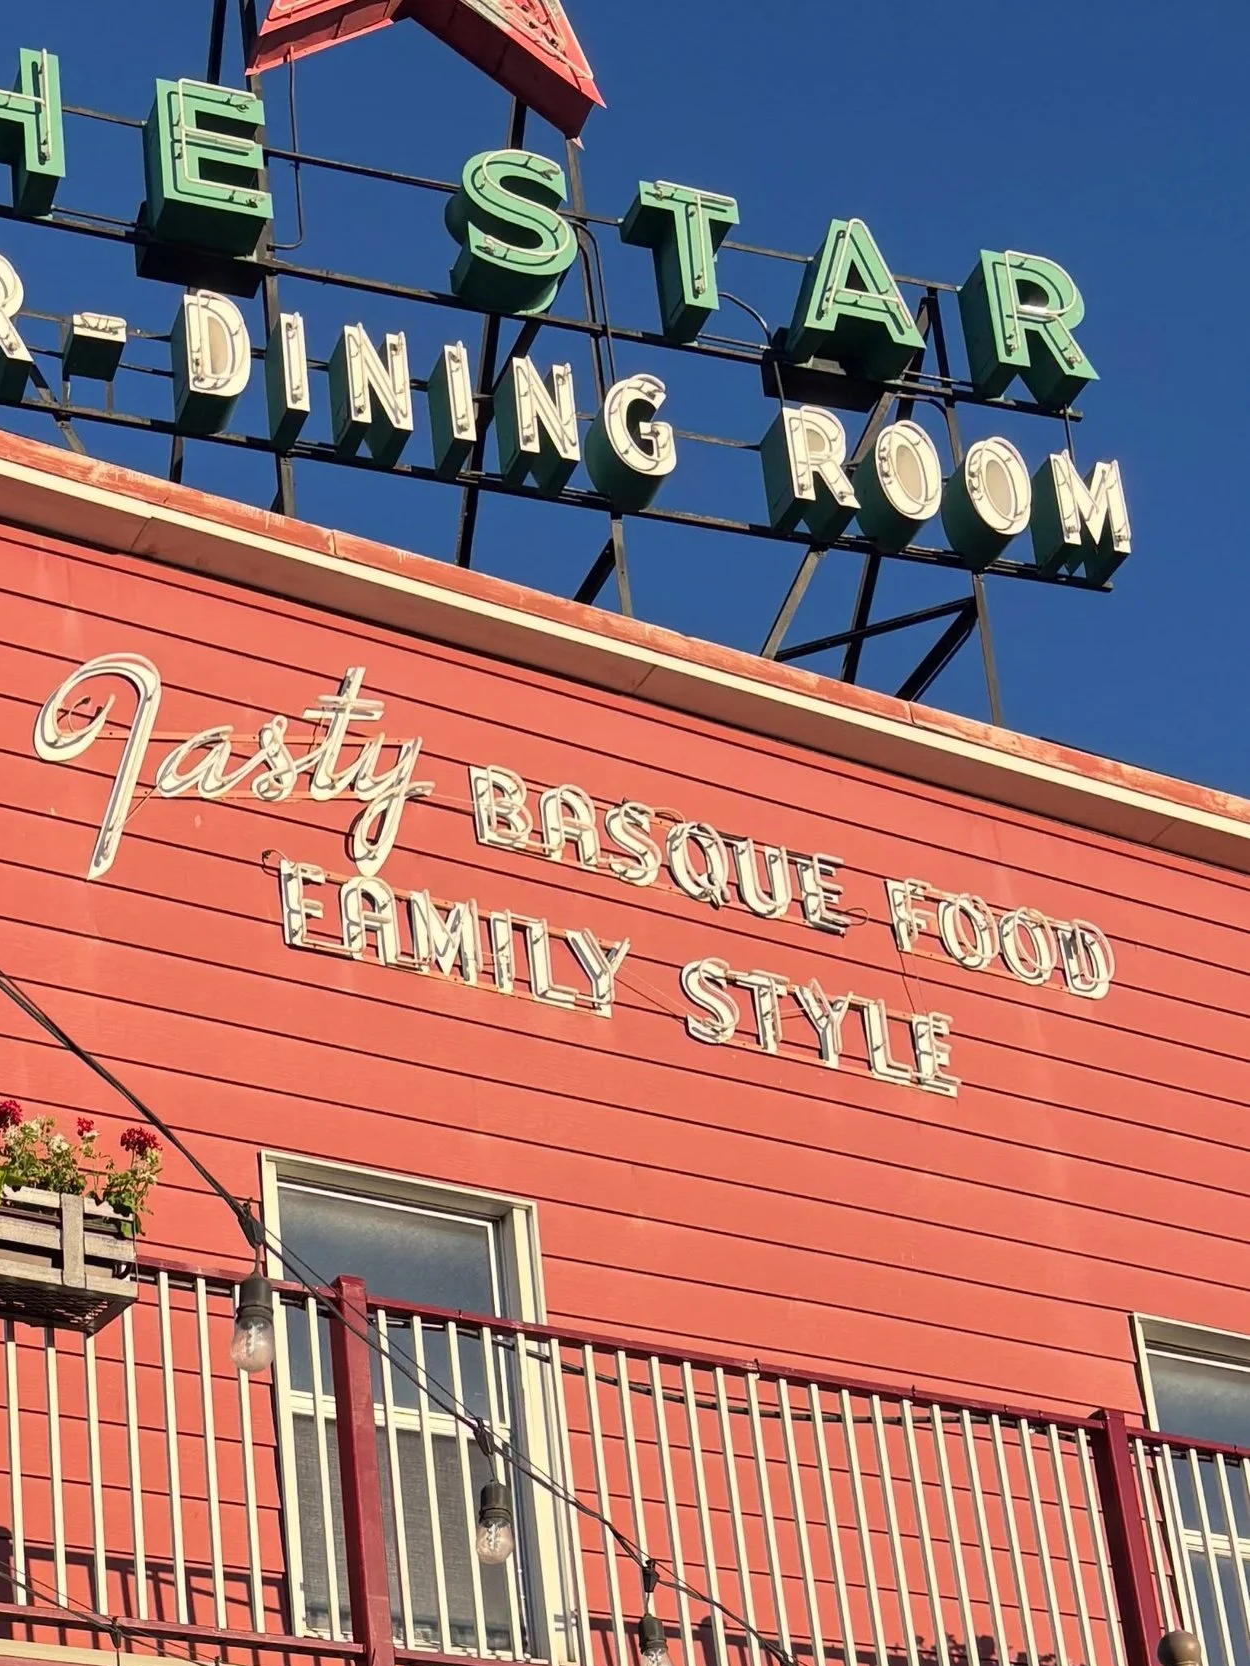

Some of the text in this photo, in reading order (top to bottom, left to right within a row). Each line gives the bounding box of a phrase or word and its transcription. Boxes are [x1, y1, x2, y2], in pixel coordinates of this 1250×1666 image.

[454, 148, 1100, 382] STAR
[778, 403, 1132, 555] ROOM
[34, 652, 1116, 1000] Tasty BASQUE FOOD
[279, 859, 961, 1099] FAMILY STYLE
